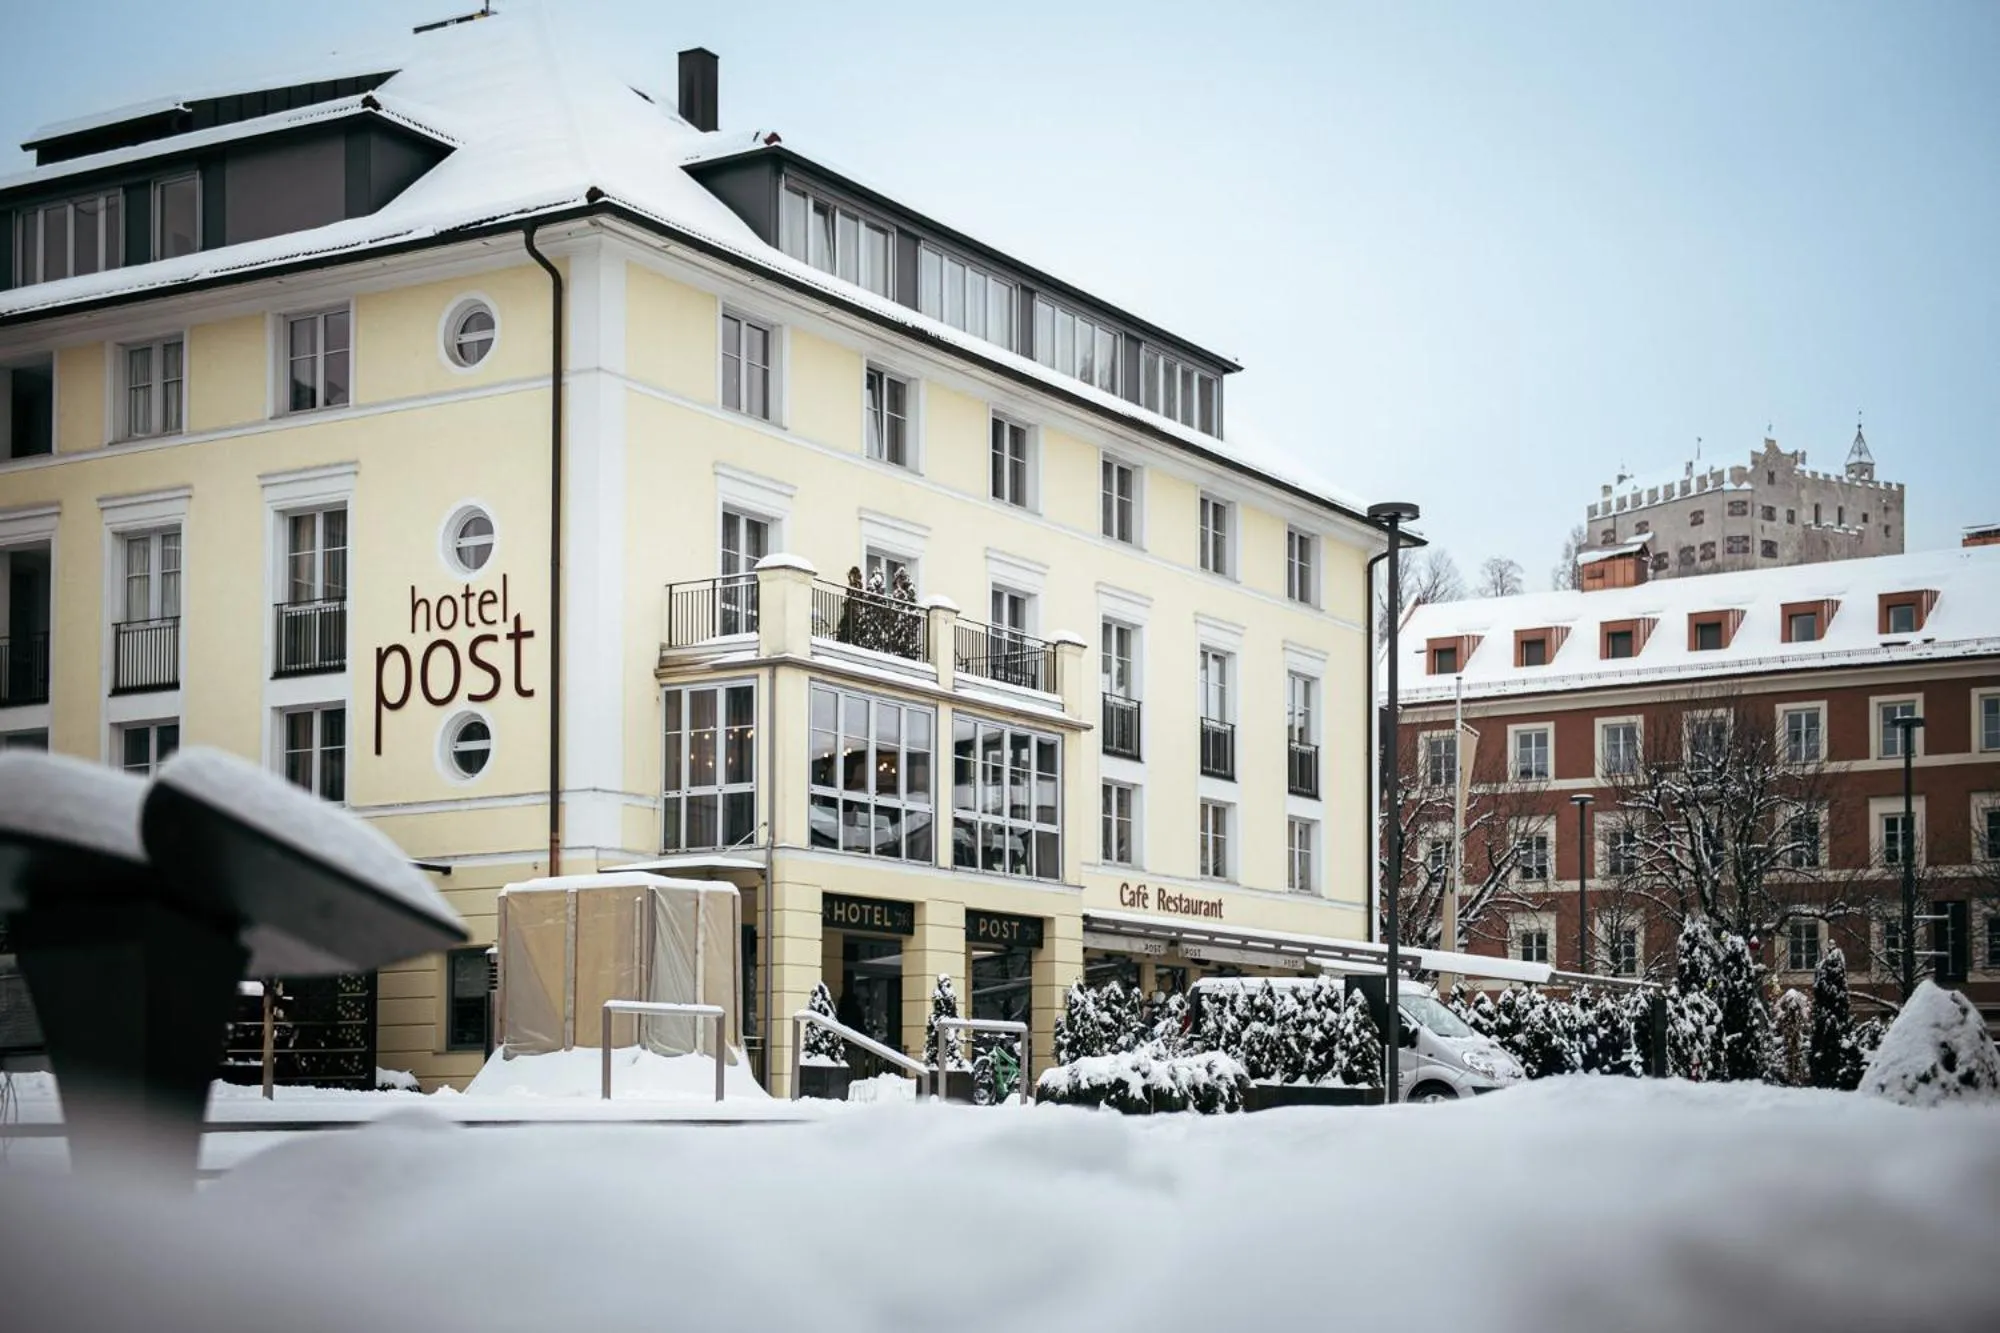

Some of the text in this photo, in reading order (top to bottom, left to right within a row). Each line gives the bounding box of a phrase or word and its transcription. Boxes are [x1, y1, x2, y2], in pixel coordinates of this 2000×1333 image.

[410, 573, 507, 634] hotel
[374, 612, 535, 756] post
[833, 900, 1020, 940] HOTEL POST
[1157, 887, 1223, 919] Restaurant
[1144, 943, 1162, 954] POST
[1184, 947, 1201, 957] POST
